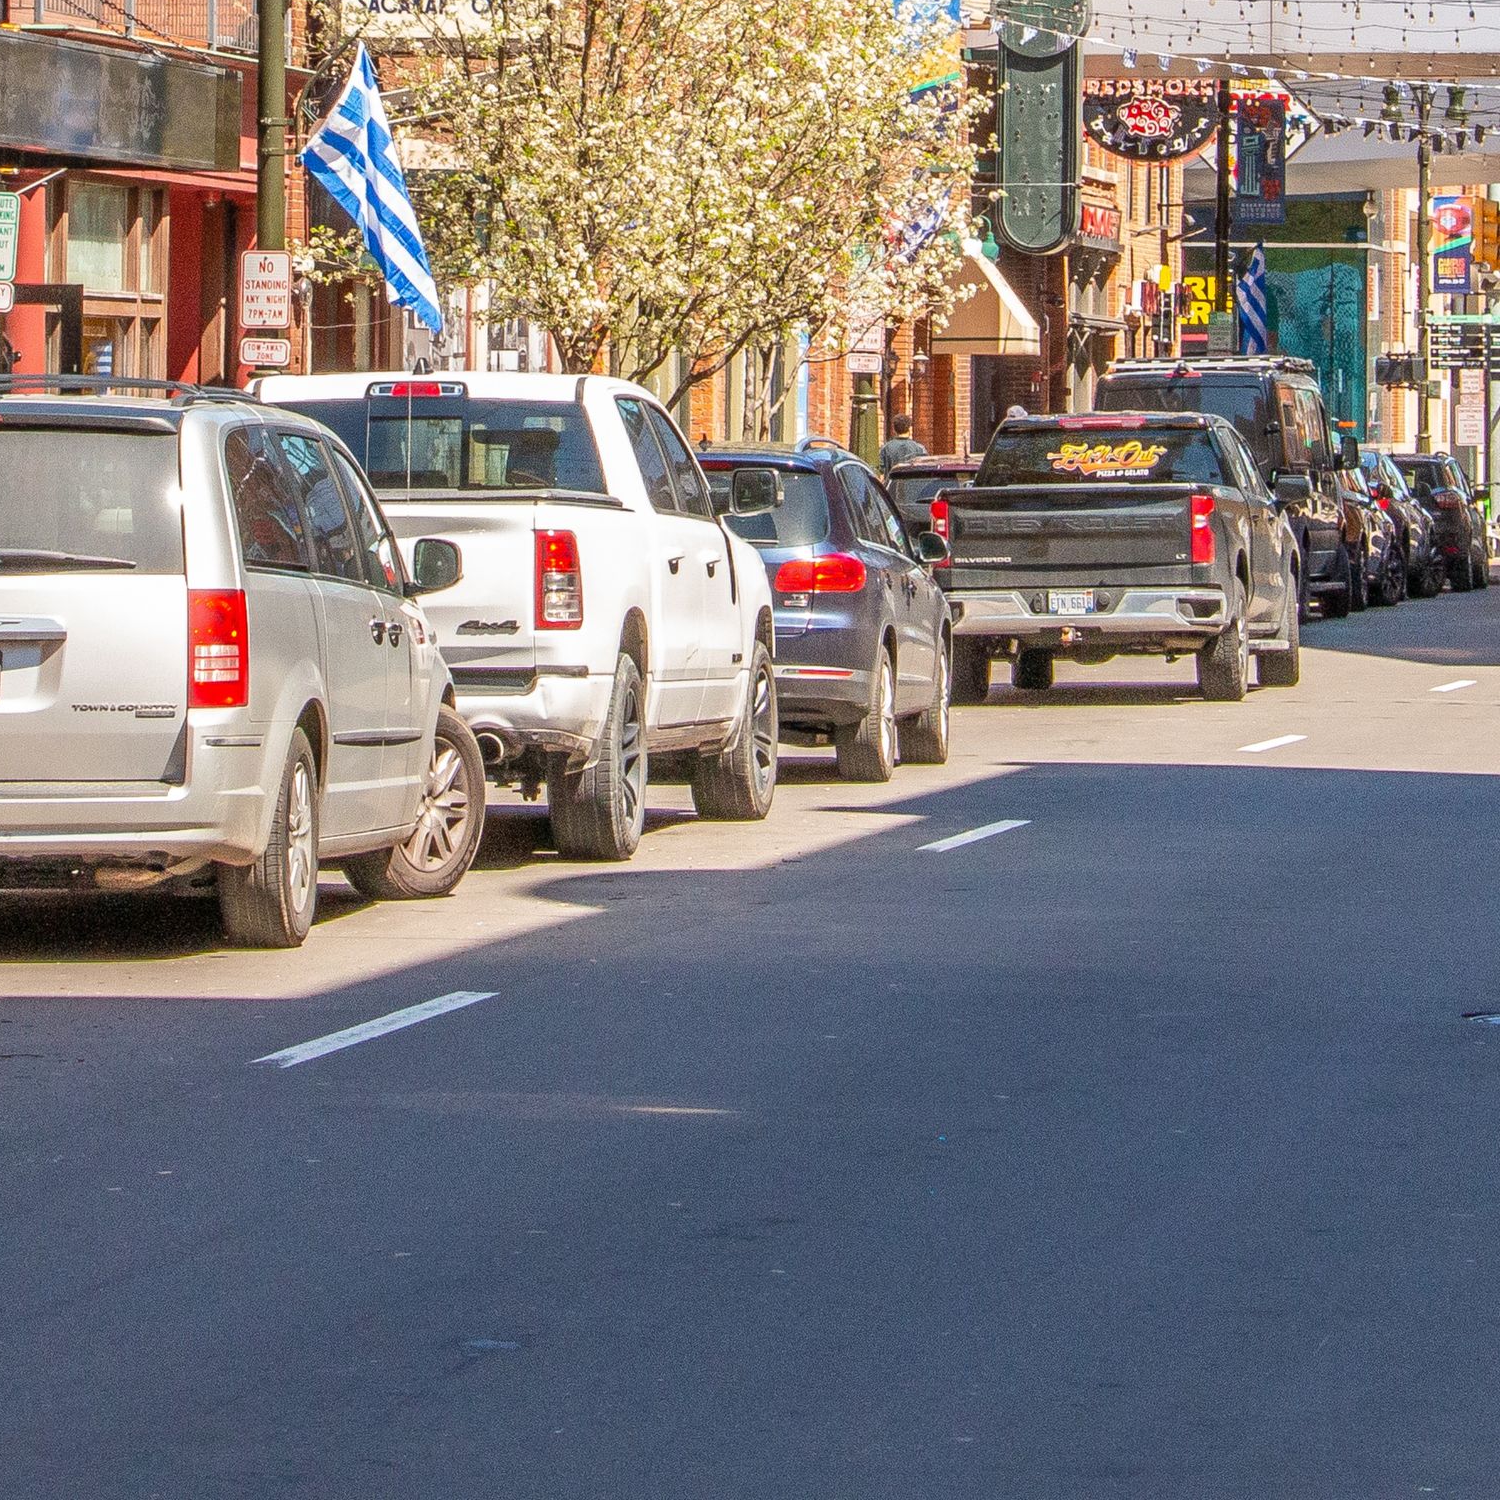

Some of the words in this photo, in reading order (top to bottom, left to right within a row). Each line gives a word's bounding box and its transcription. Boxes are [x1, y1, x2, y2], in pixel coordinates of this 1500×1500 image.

[258, 261, 274, 273] NO
[244, 280, 288, 290] STANDING
[245, 294, 259, 304] ANY
[266, 294, 286, 304] NIGHT
[248, 308, 283, 319] 7PM-7AM
[256, 352, 275, 360] ZONE
